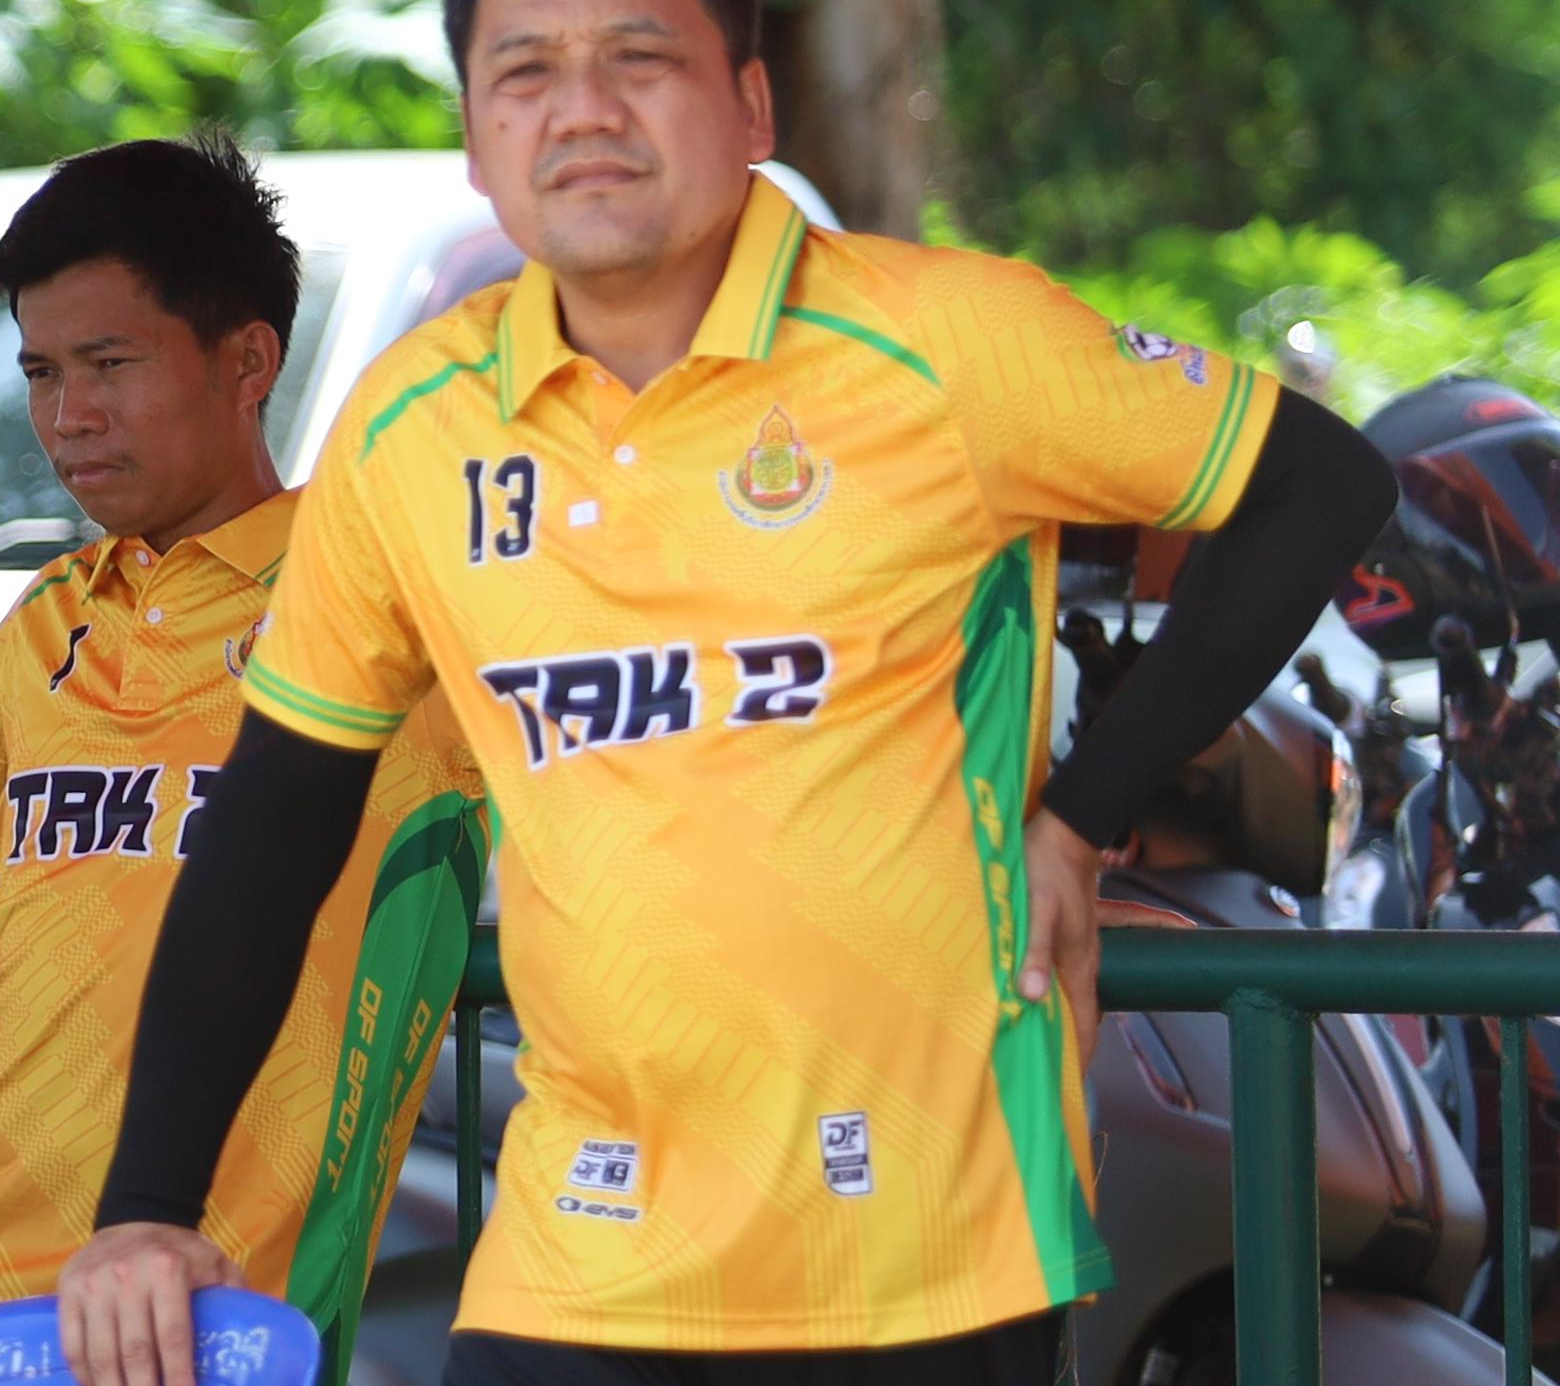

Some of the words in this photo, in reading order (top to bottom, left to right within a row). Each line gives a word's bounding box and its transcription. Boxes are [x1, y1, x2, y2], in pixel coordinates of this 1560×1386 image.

[463, 453, 537, 564] 13
[475, 641, 702, 773] TAK
[721, 633, 833, 726] 2
[5, 764, 166, 867] TAK
[357, 976, 384, 1046] DF
